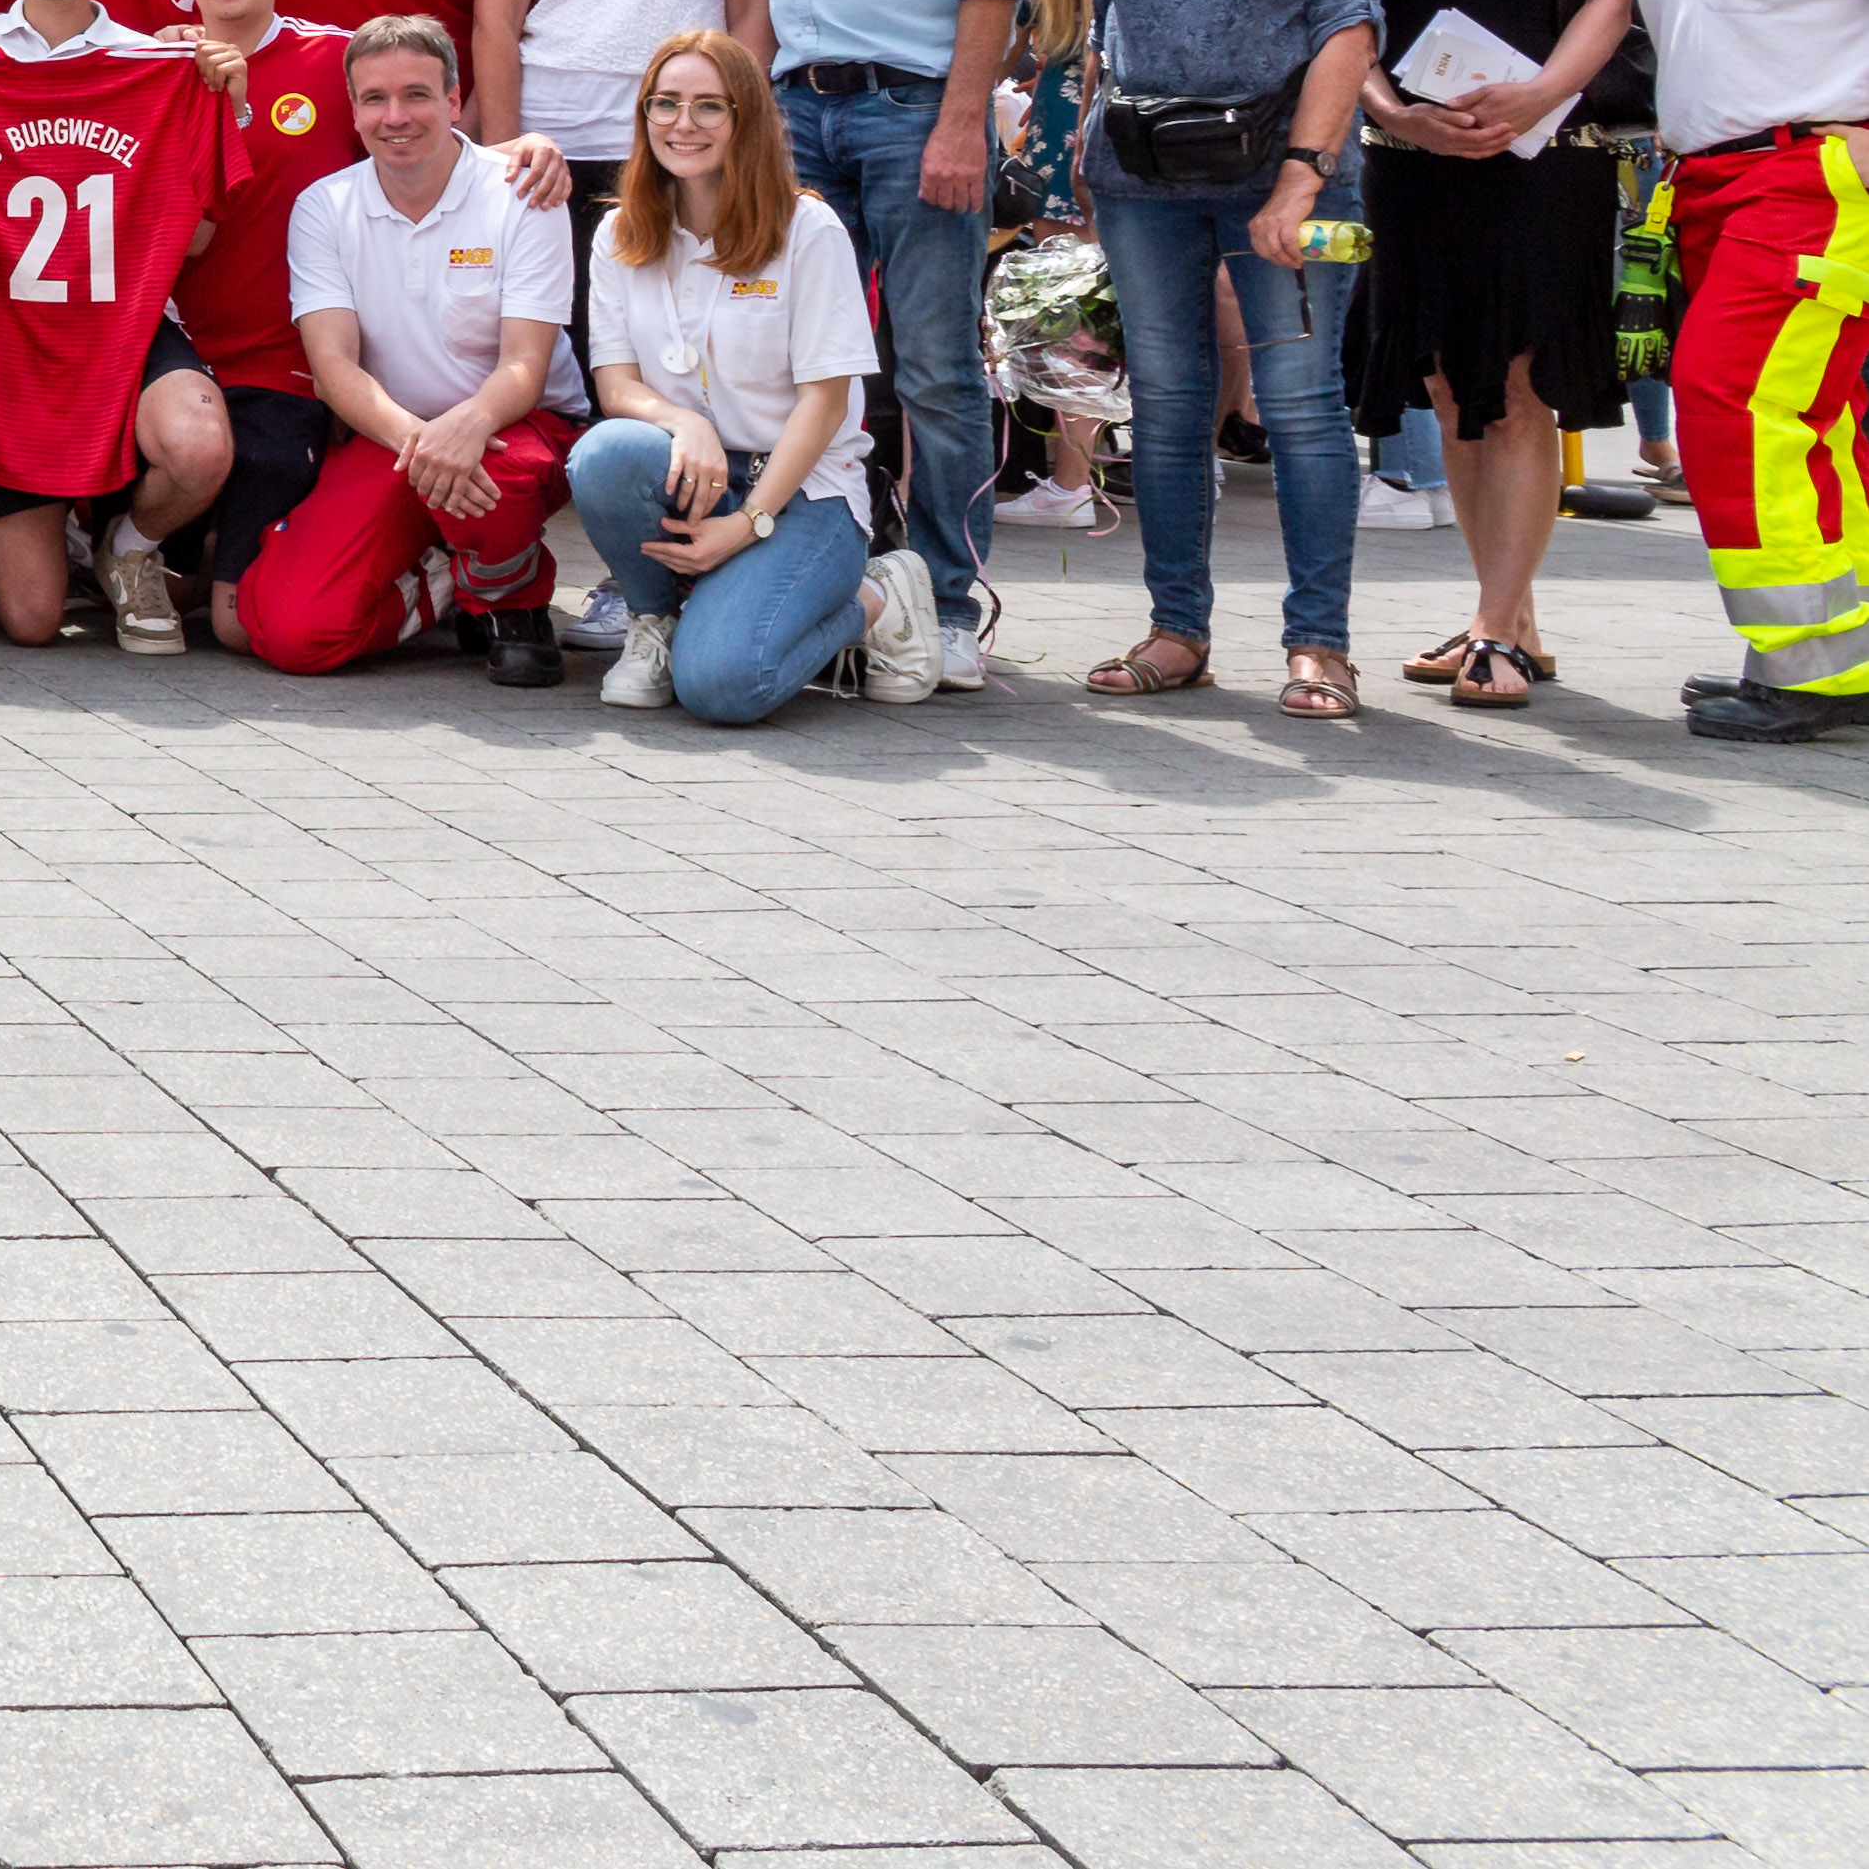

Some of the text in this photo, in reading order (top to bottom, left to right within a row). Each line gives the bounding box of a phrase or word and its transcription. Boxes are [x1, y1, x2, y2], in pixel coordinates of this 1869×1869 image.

[1435, 52, 1453, 77] NKR
[4, 117, 141, 171] BURGWEDEL
[7, 174, 116, 303] 21
